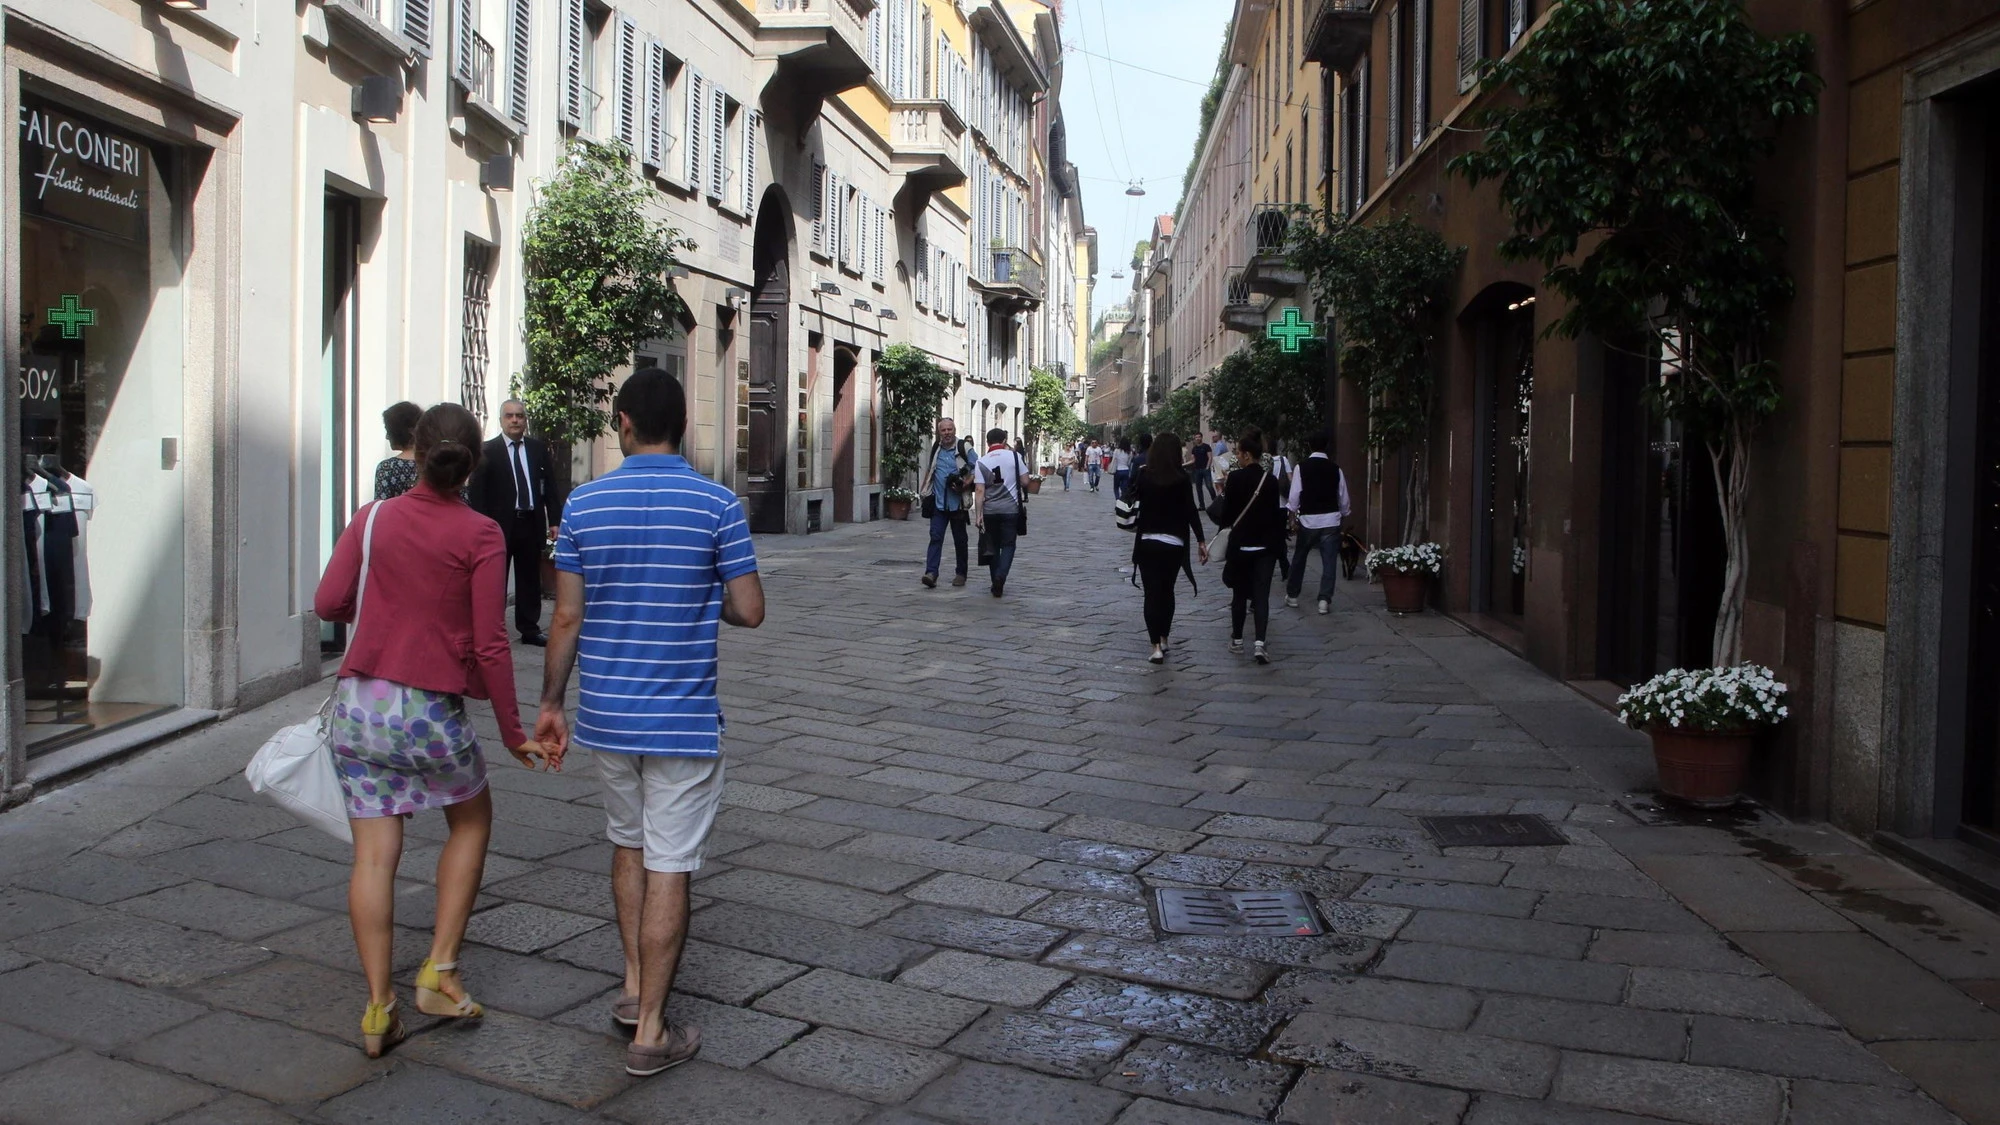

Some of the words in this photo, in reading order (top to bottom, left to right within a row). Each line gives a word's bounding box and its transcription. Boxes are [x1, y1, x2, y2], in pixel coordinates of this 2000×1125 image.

[19, 105, 139, 177] FALCONERI
[34, 153, 83, 199] filati
[87, 185, 138, 209] naturali
[992, 465, 1004, 484] 1
